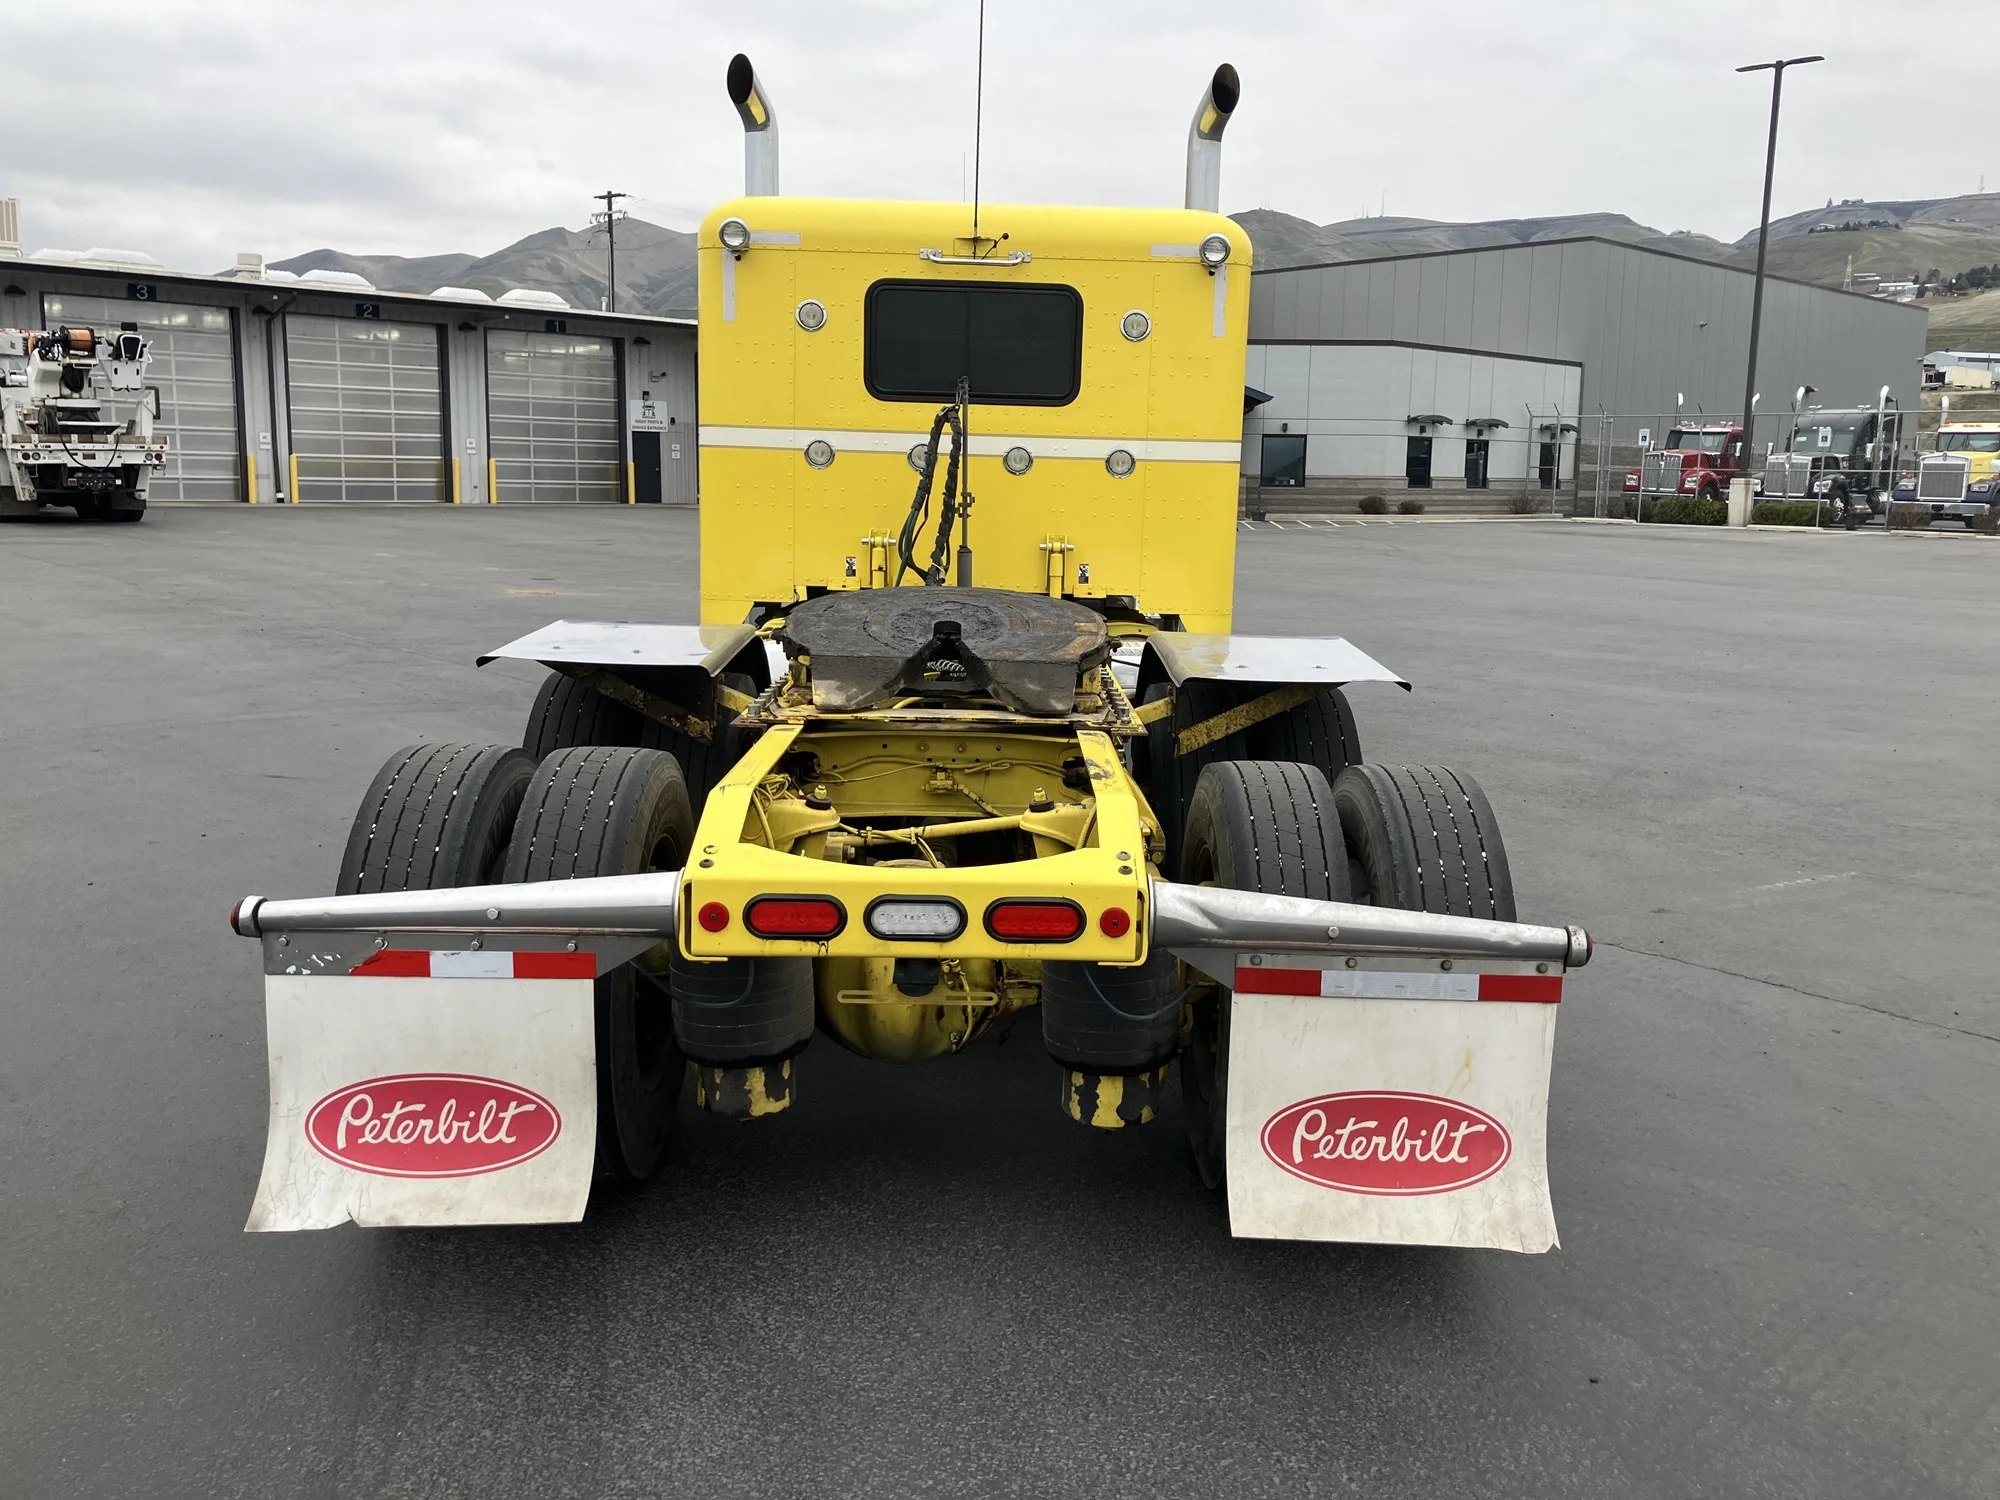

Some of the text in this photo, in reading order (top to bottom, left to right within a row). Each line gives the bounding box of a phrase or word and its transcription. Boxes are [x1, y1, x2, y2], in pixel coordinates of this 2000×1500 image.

[136, 284, 148, 300] 3
[363, 304, 373, 318] 2
[336, 1093, 538, 1151] Peterbilt
[1292, 1108, 1488, 1165] Peterbilt
